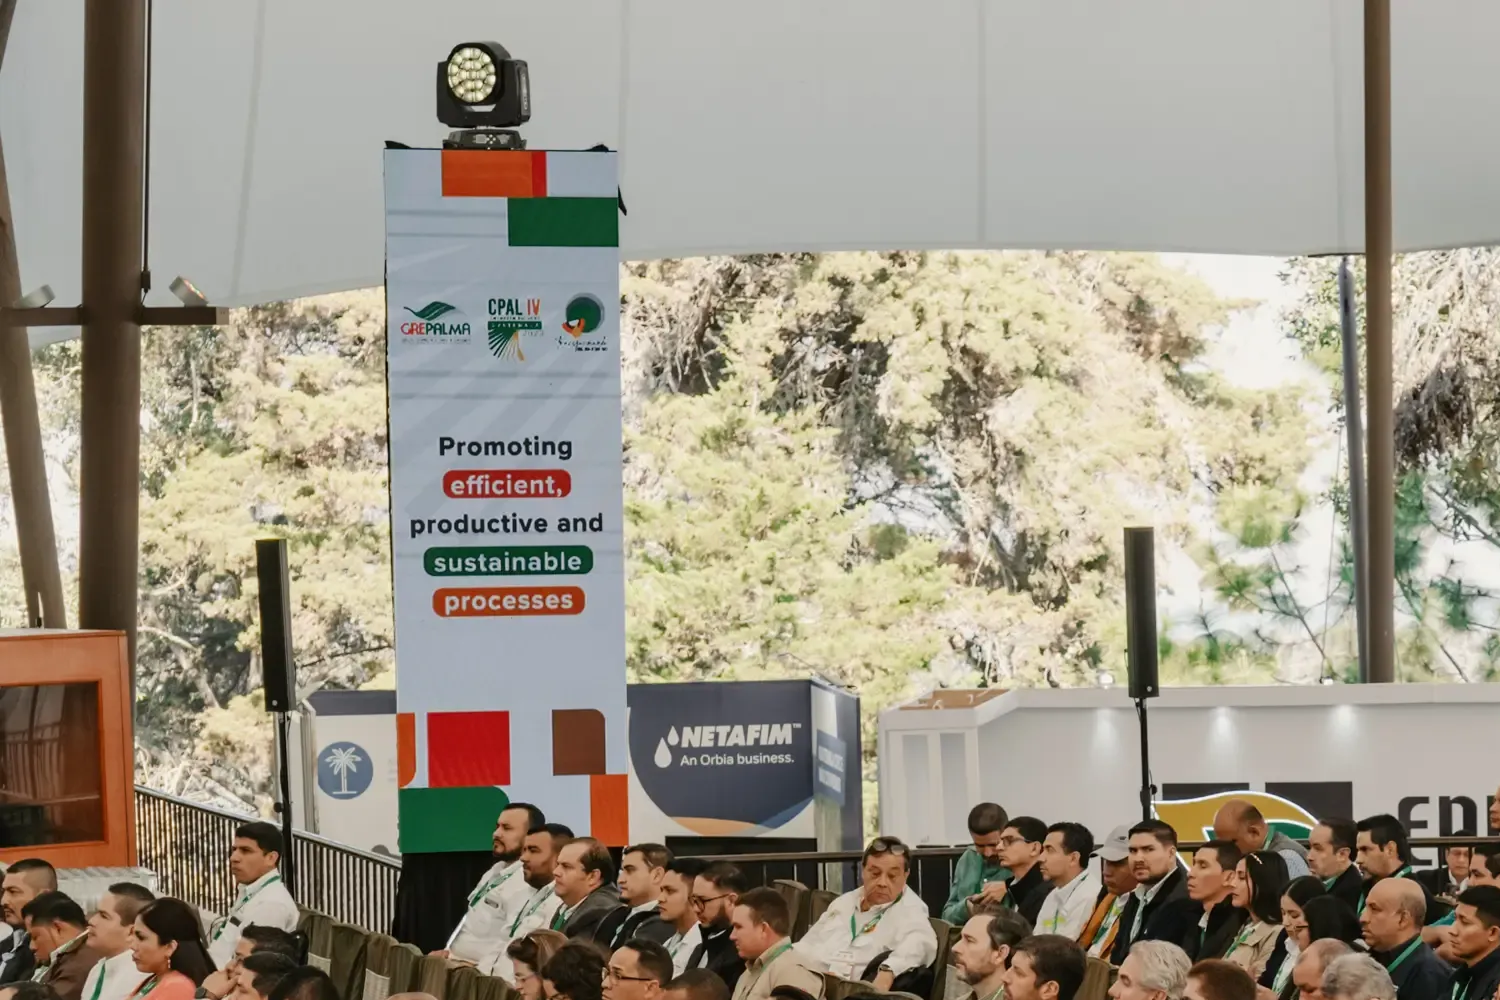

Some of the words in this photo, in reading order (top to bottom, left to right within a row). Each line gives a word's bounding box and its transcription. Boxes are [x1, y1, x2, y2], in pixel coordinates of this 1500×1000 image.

[488, 298, 523, 316] CPAL
[527, 298, 541, 315] IV
[400, 322, 471, 335] GREPALMA
[439, 436, 573, 460] Promoting
[450, 475, 563, 498] efficient,
[410, 514, 548, 538] productive
[557, 513, 603, 533] and
[434, 552, 582, 572] sustainable
[444, 592, 573, 615] processes
[680, 755, 697, 766] An
[700, 754, 734, 766] Orbia
[737, 752, 795, 765] business.
